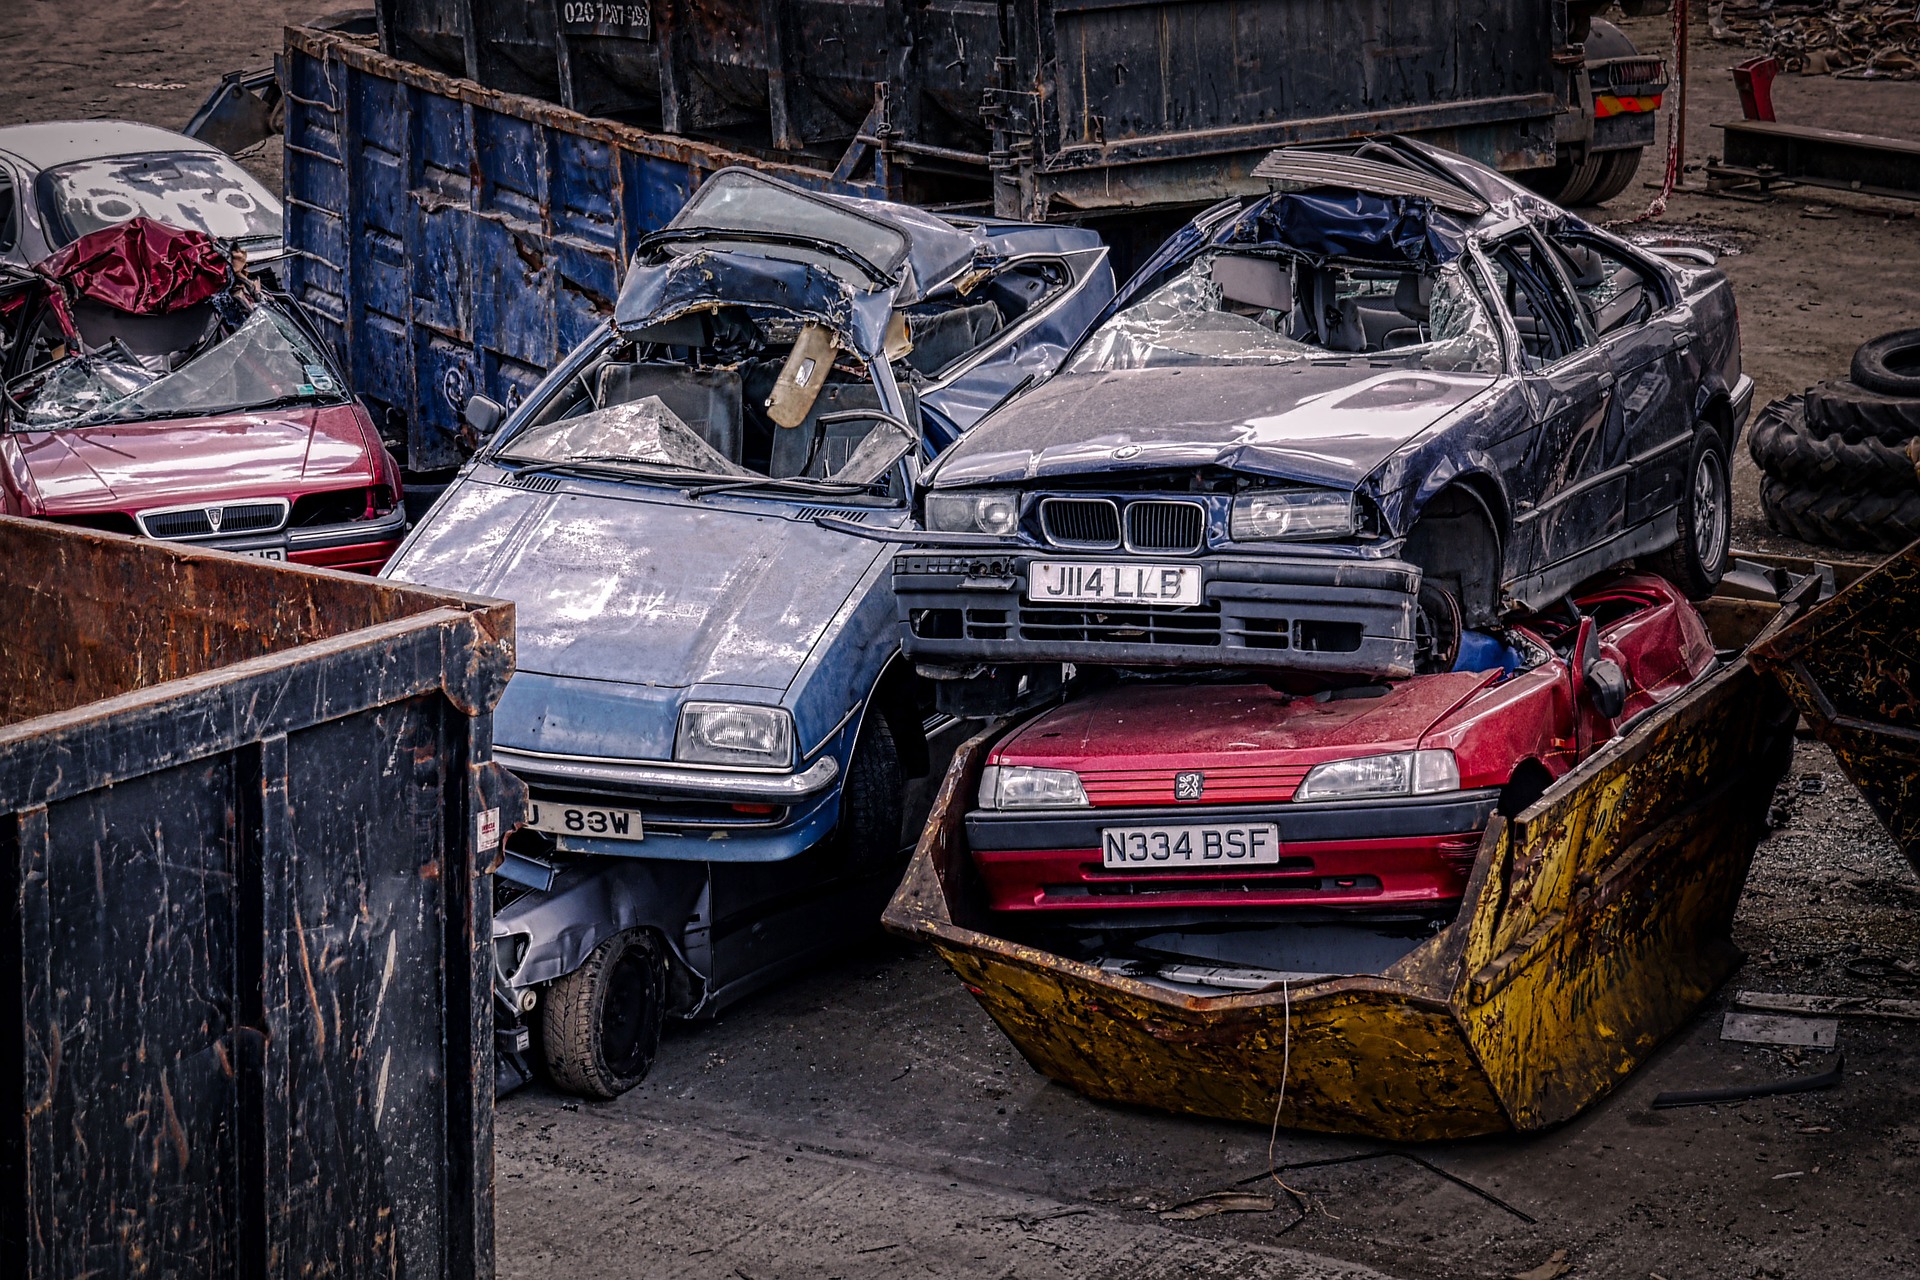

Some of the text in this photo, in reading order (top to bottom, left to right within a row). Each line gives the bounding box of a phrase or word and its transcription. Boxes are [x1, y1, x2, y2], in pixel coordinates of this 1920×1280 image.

[1046, 566, 1182, 599] J114 LLB
[564, 809, 630, 835] 83W
[1107, 828, 1269, 862] N334 BSF
